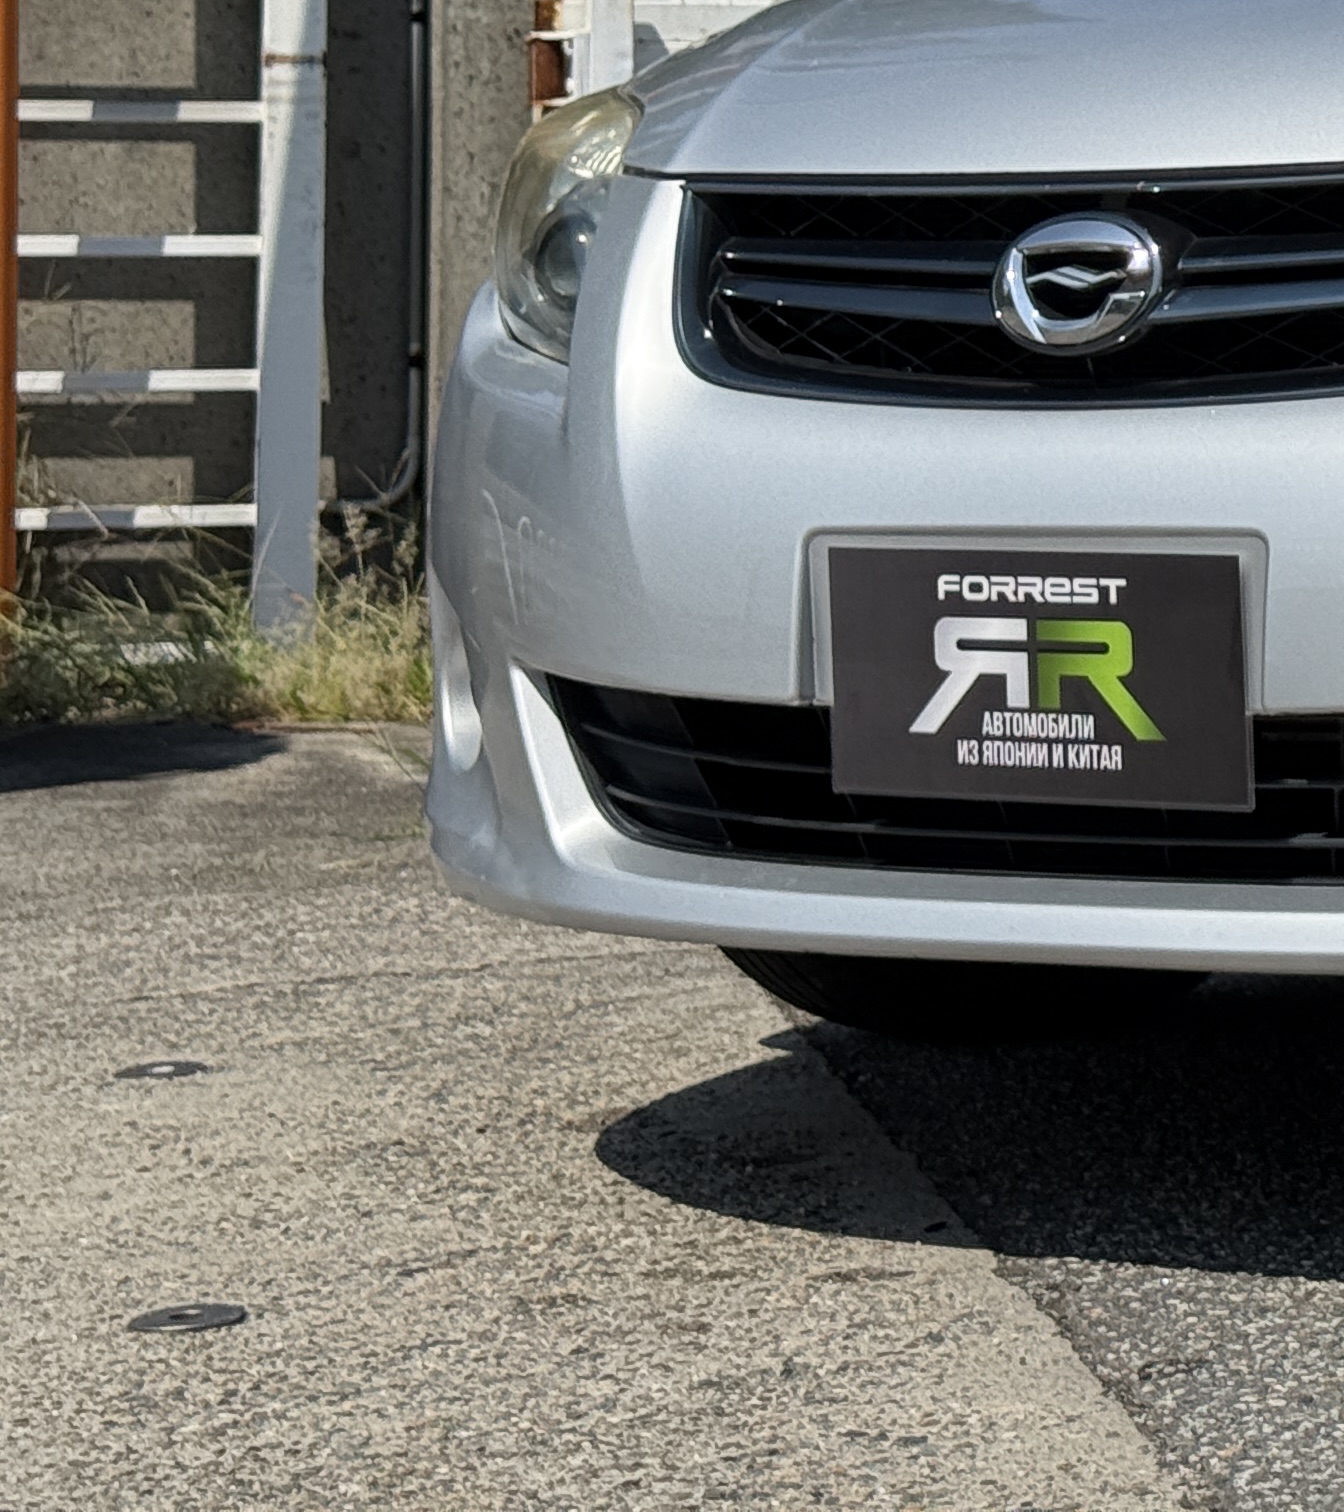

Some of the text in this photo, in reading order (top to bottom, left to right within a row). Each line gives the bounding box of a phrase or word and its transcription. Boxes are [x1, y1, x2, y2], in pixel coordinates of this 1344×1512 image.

[981, 711, 1095, 739] АВТОМОБИЛИ
[957, 740, 1123, 770] ИЗ ЯПОНИИ И КИТАЯ
